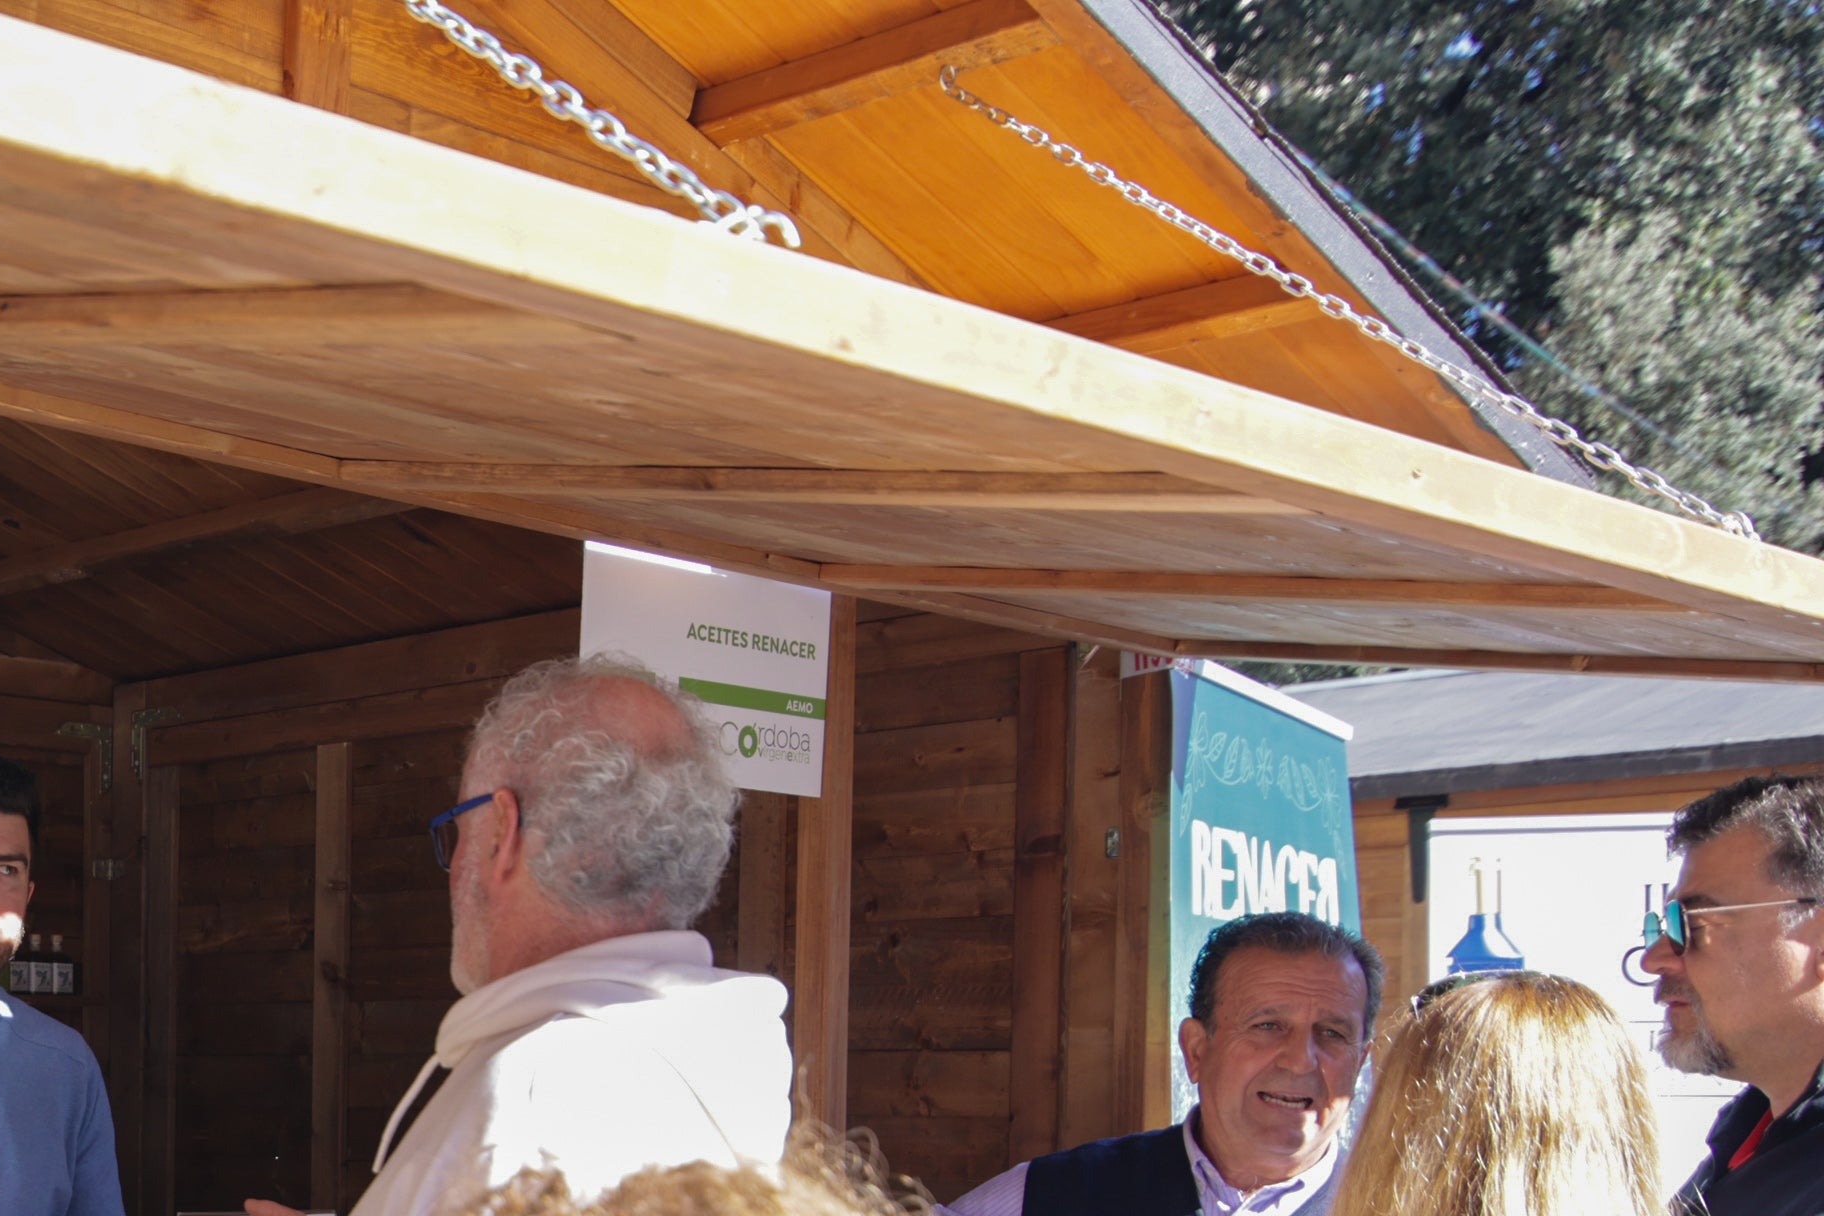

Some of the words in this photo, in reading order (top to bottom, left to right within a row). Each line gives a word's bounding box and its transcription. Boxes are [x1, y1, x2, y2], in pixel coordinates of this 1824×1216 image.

[686, 622, 749, 649] ACEITES
[751, 633, 817, 661] RENACER
[785, 699, 814, 714] AEMO
[718, 720, 811, 758] Córdoba
